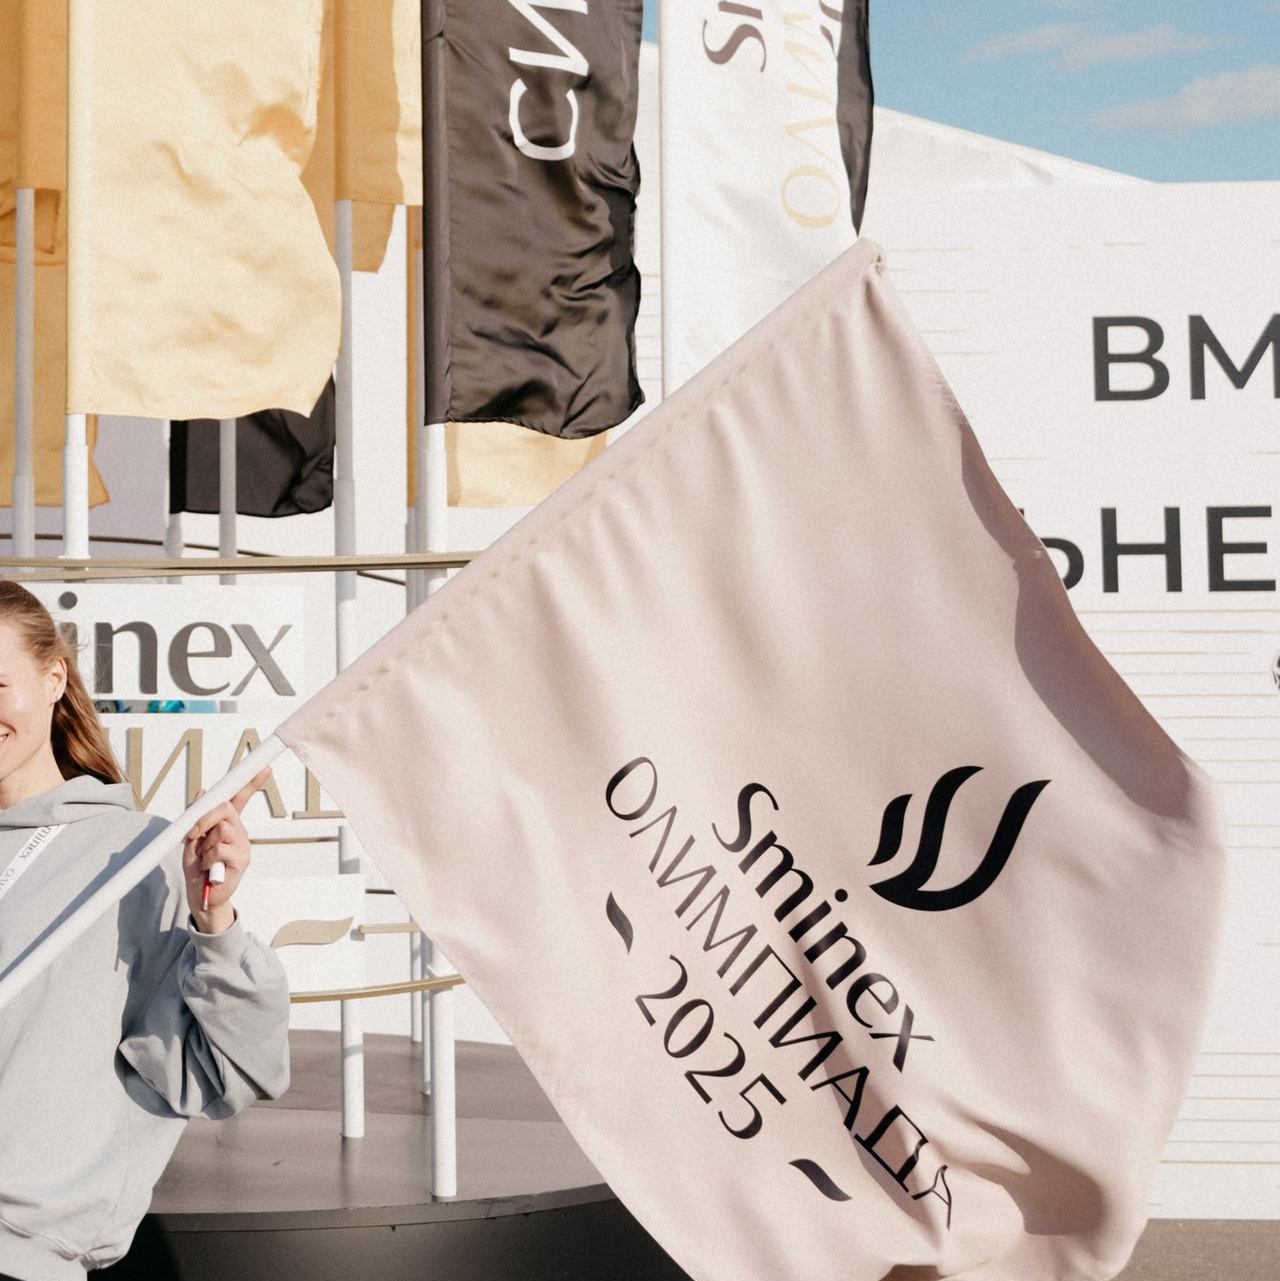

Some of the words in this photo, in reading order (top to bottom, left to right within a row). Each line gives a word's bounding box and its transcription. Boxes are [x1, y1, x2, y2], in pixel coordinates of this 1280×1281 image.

[604, 754, 955, 1231] ОЛИМПИАДА
[634, 954, 788, 1141] 2025
[710, 781, 936, 1073] Sminex
